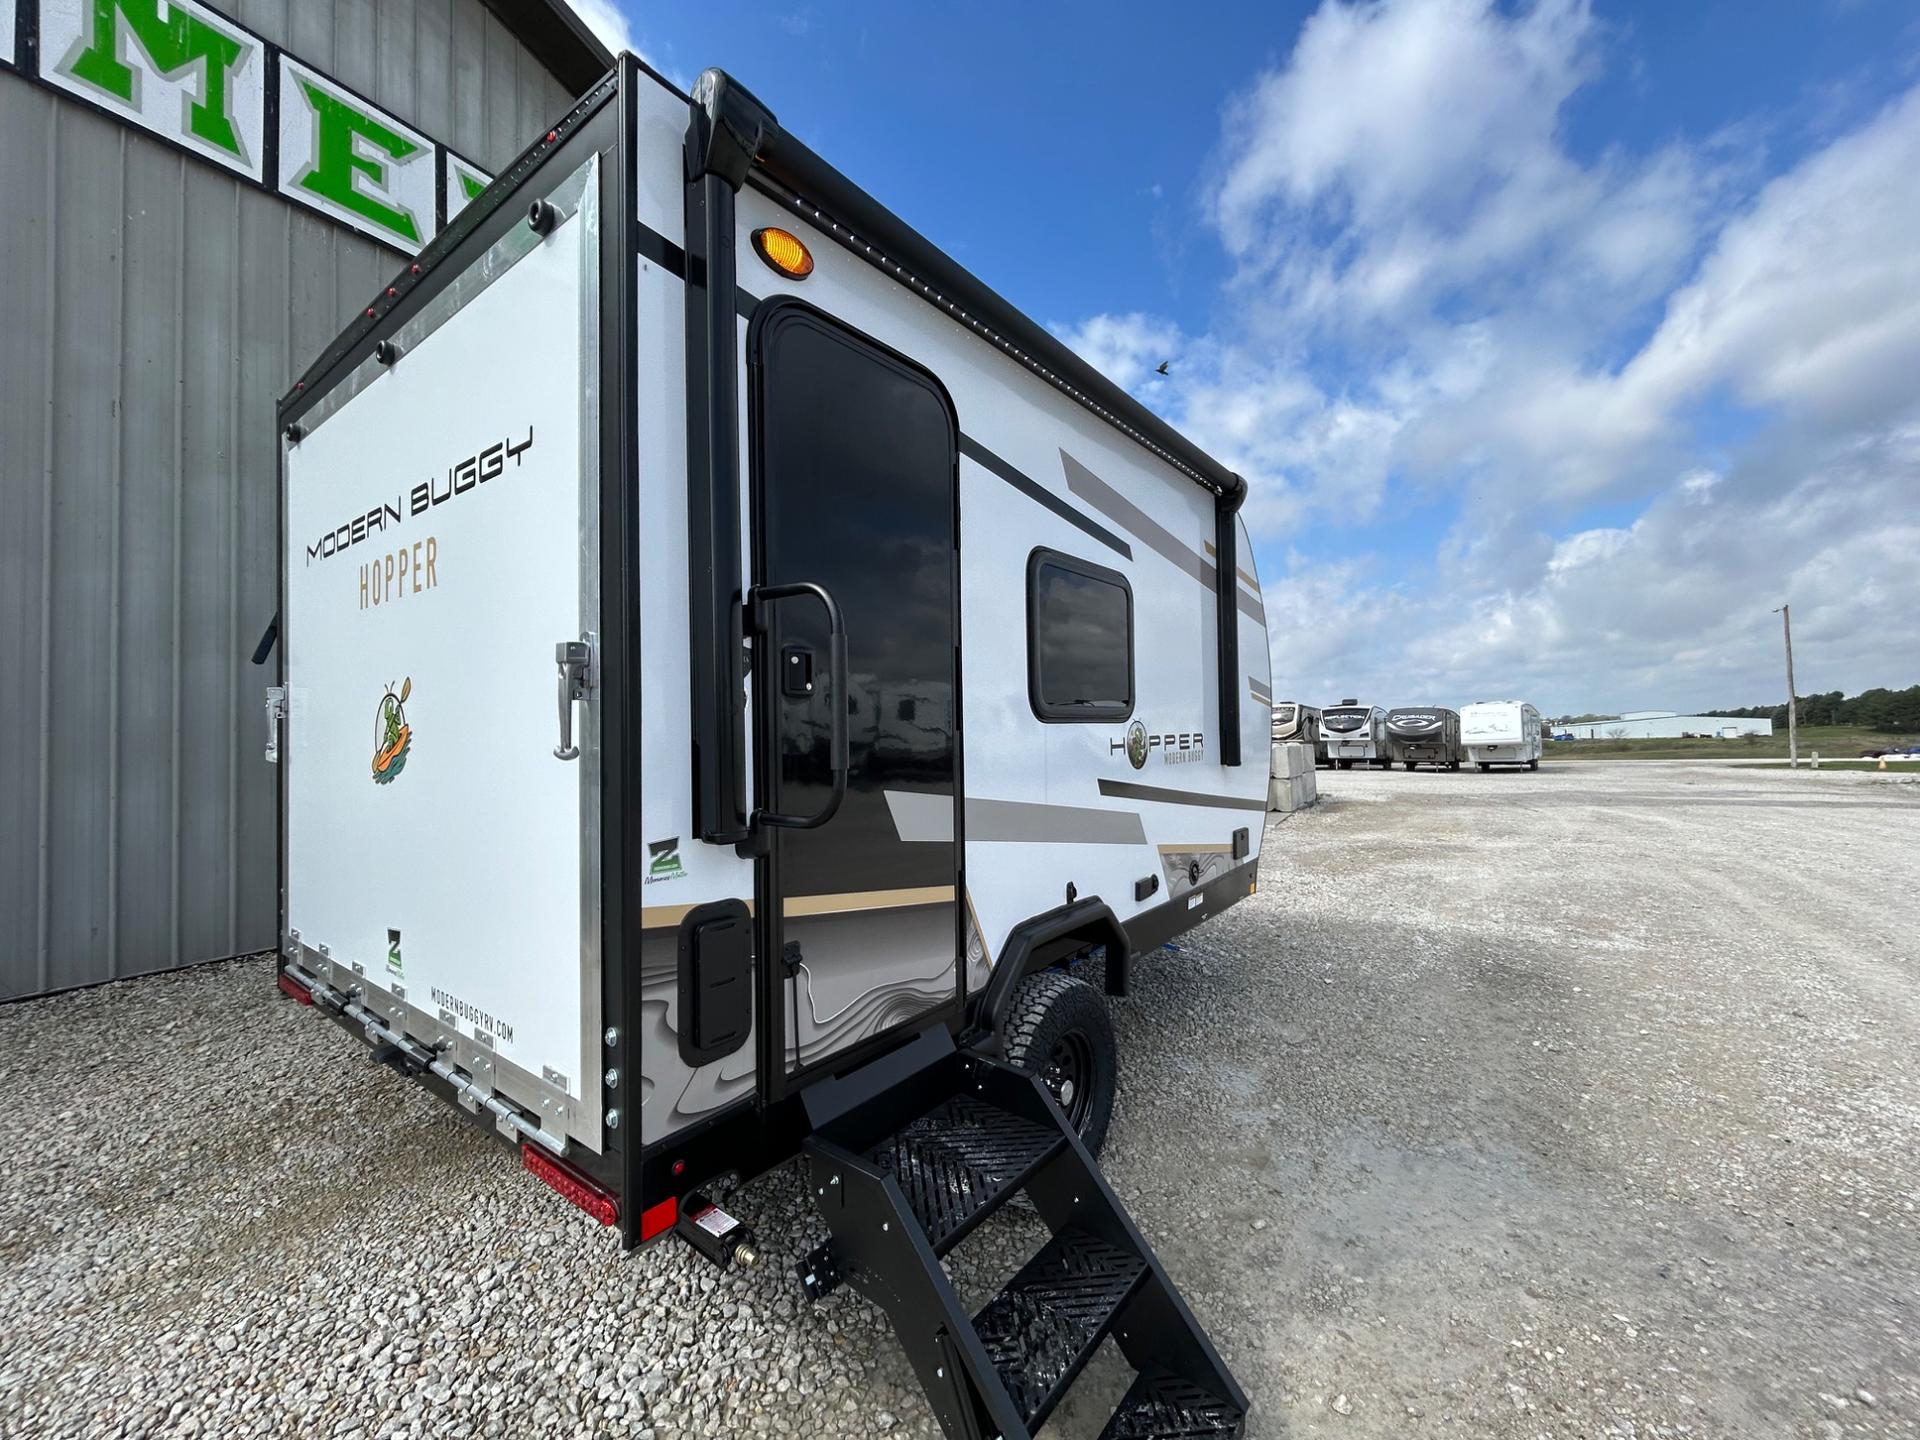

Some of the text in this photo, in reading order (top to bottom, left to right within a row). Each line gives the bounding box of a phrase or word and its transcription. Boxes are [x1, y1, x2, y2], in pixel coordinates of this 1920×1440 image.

[53, 0, 492, 246] ME
[306, 424, 534, 568] MODERN BUGGY
[359, 536, 438, 610] HOPPER
[430, 985, 514, 1044] MODERNBUGGYRV.COM
